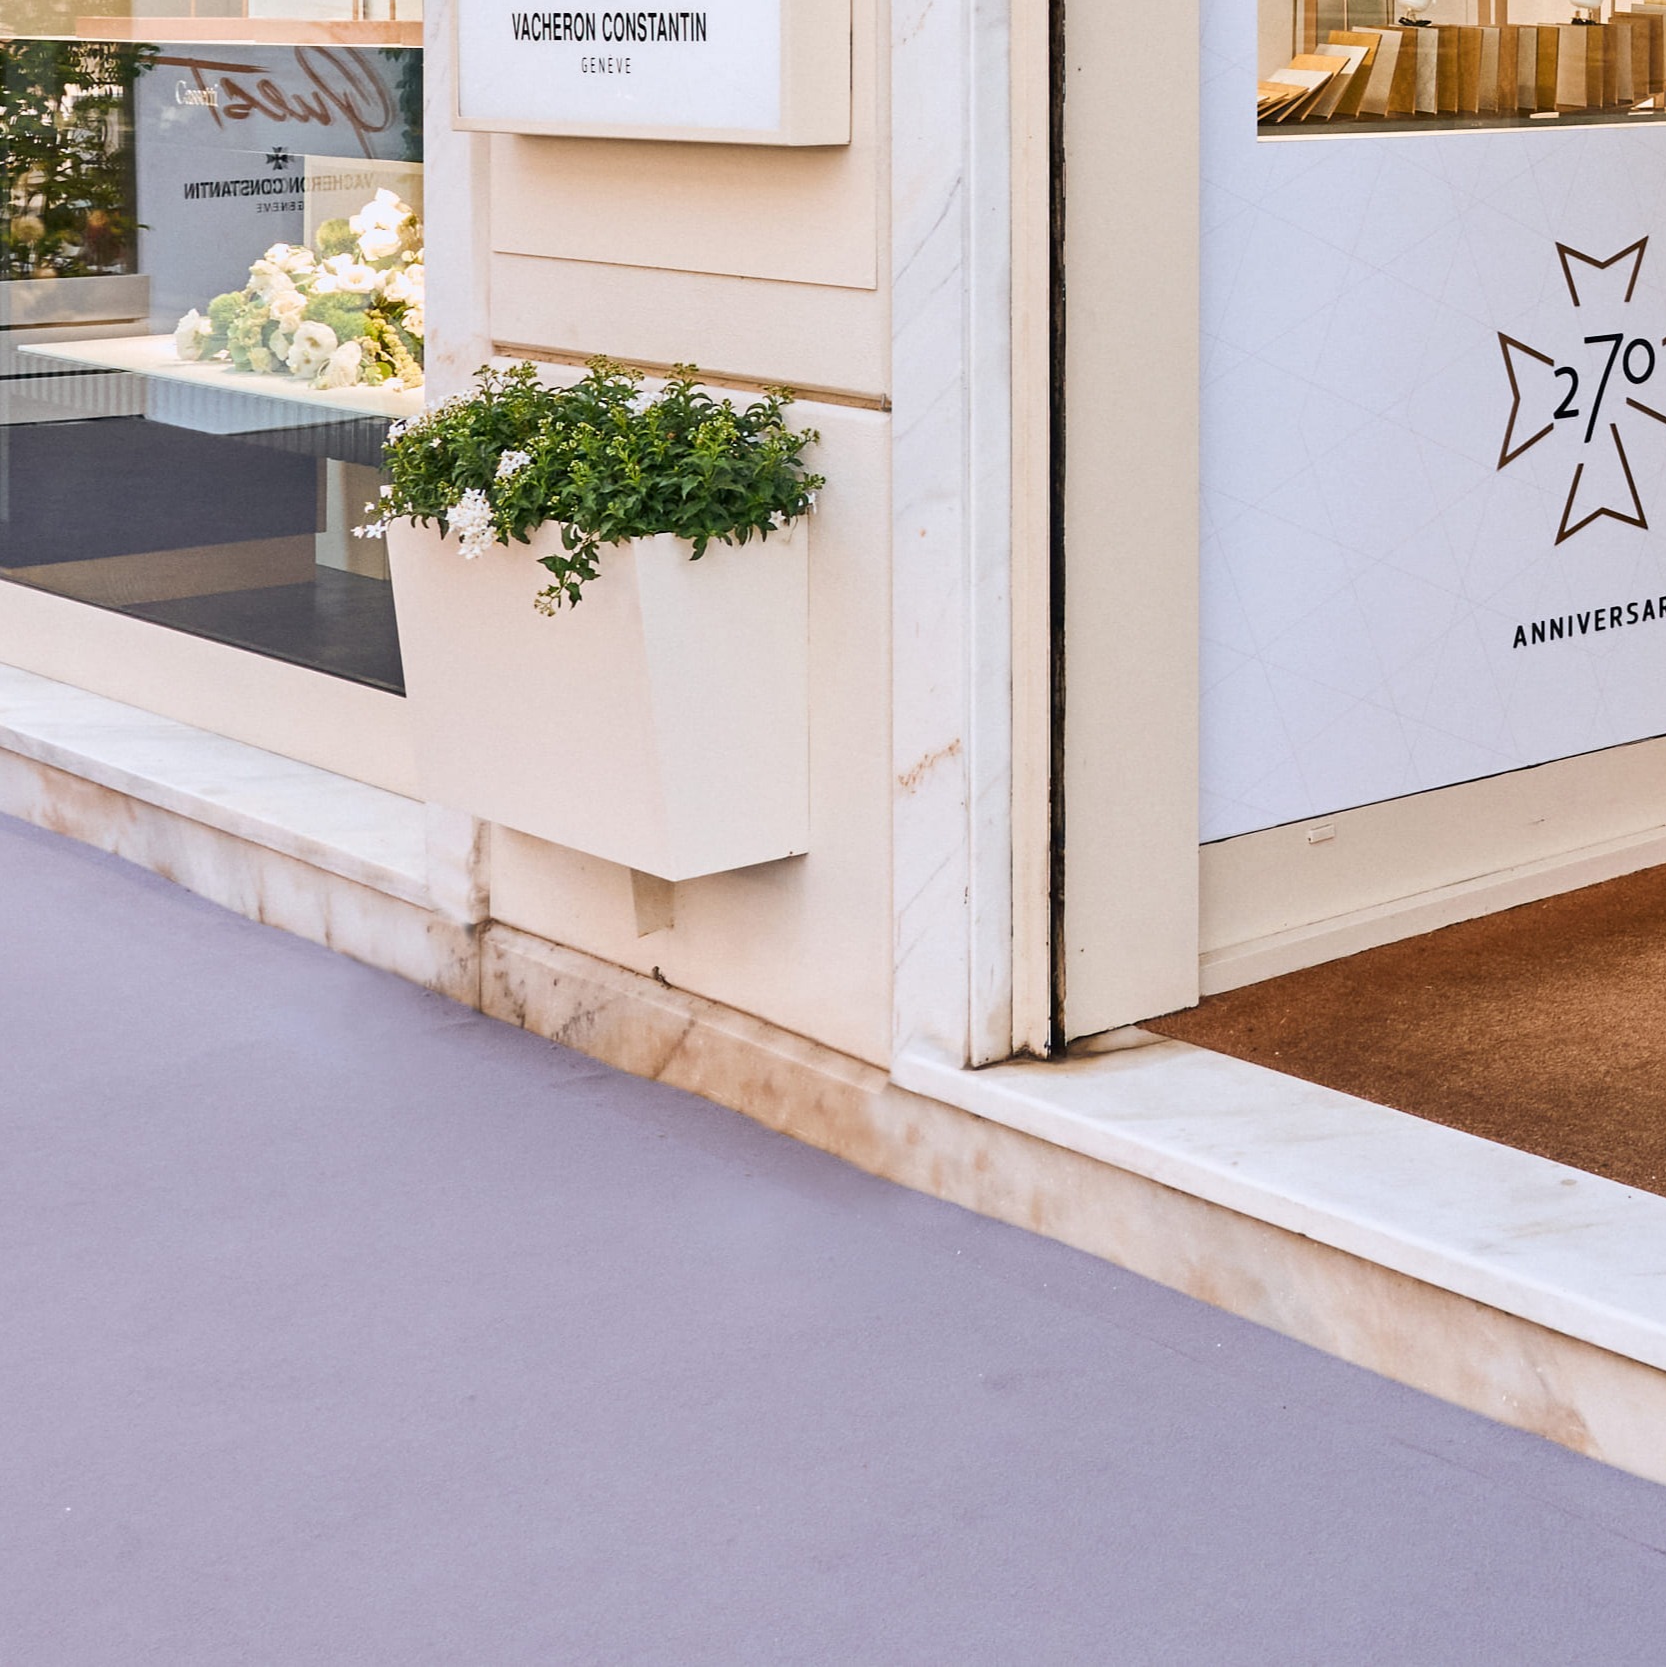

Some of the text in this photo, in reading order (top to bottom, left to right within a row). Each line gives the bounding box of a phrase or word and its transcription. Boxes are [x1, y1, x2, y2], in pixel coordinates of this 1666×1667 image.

[511, 12, 707, 42] VACHERON CONSTANTIN
[1553, 333, 1656, 443] 270
